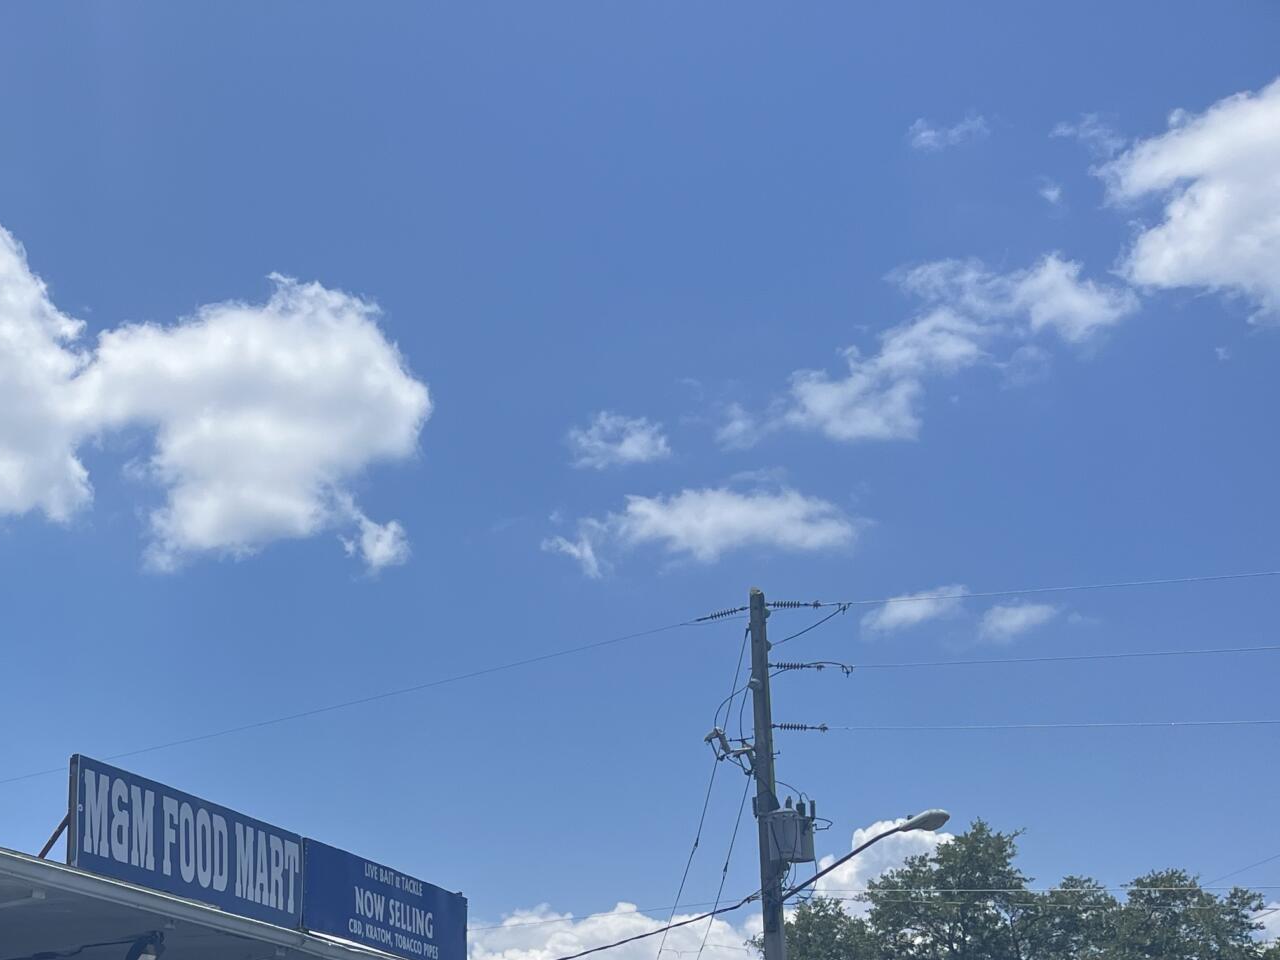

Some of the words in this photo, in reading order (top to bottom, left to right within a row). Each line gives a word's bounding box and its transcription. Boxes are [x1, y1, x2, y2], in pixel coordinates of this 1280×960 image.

[83, 768, 155, 871] M&M
[162, 796, 228, 892] FOOD
[234, 823, 299, 915] MART
[364, 862, 378, 880] LIVE
[379, 868, 394, 887] BAIT
[401, 877, 423, 896] TACKLE
[354, 886, 386, 922] NOW
[388, 898, 434, 939] SELLING
[348, 918, 364, 938] CBD,
[365, 923, 394, 948] KRATOM,
[394, 932, 422, 955] TOBACCO
[423, 943, 439, 960] PIPES
